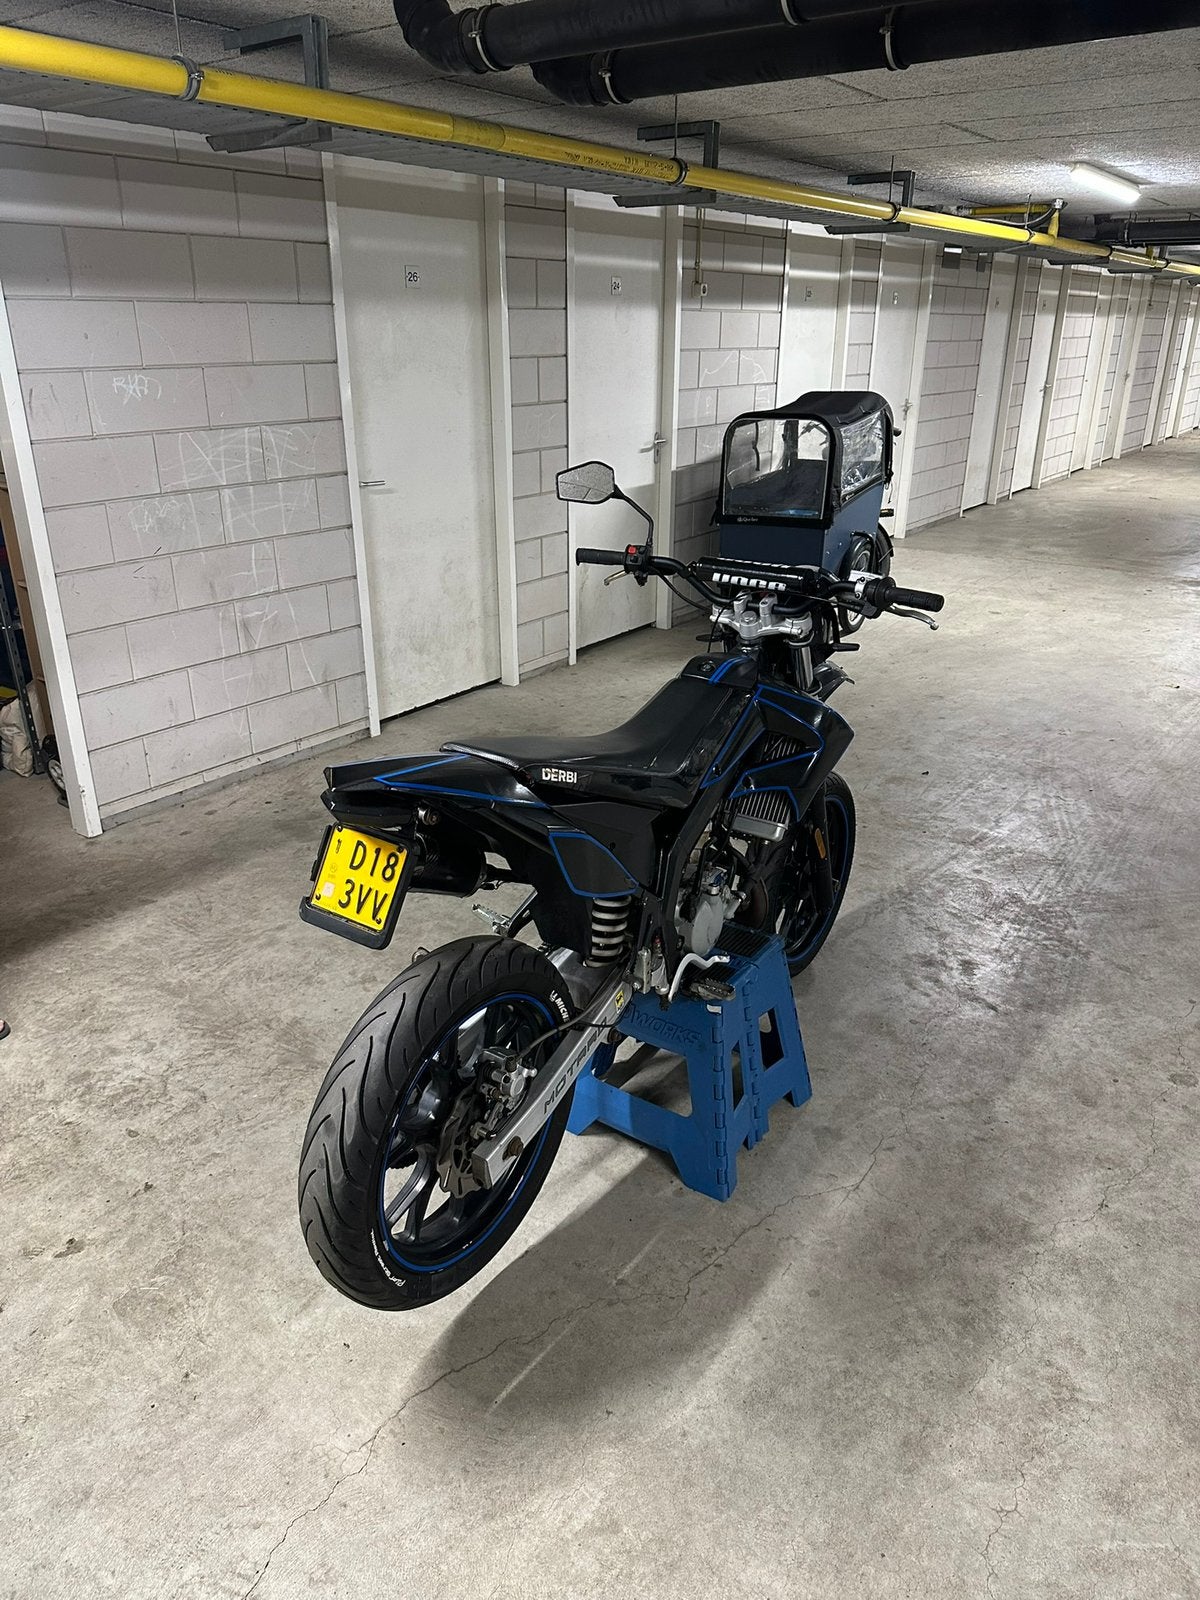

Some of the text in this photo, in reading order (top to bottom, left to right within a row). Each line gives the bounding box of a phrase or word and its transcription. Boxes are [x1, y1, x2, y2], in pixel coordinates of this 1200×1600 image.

[408, 271, 418, 282] 26
[541, 767, 578, 784] DERBI
[348, 839, 399, 883] D18
[338, 878, 389, 921] 3VV
